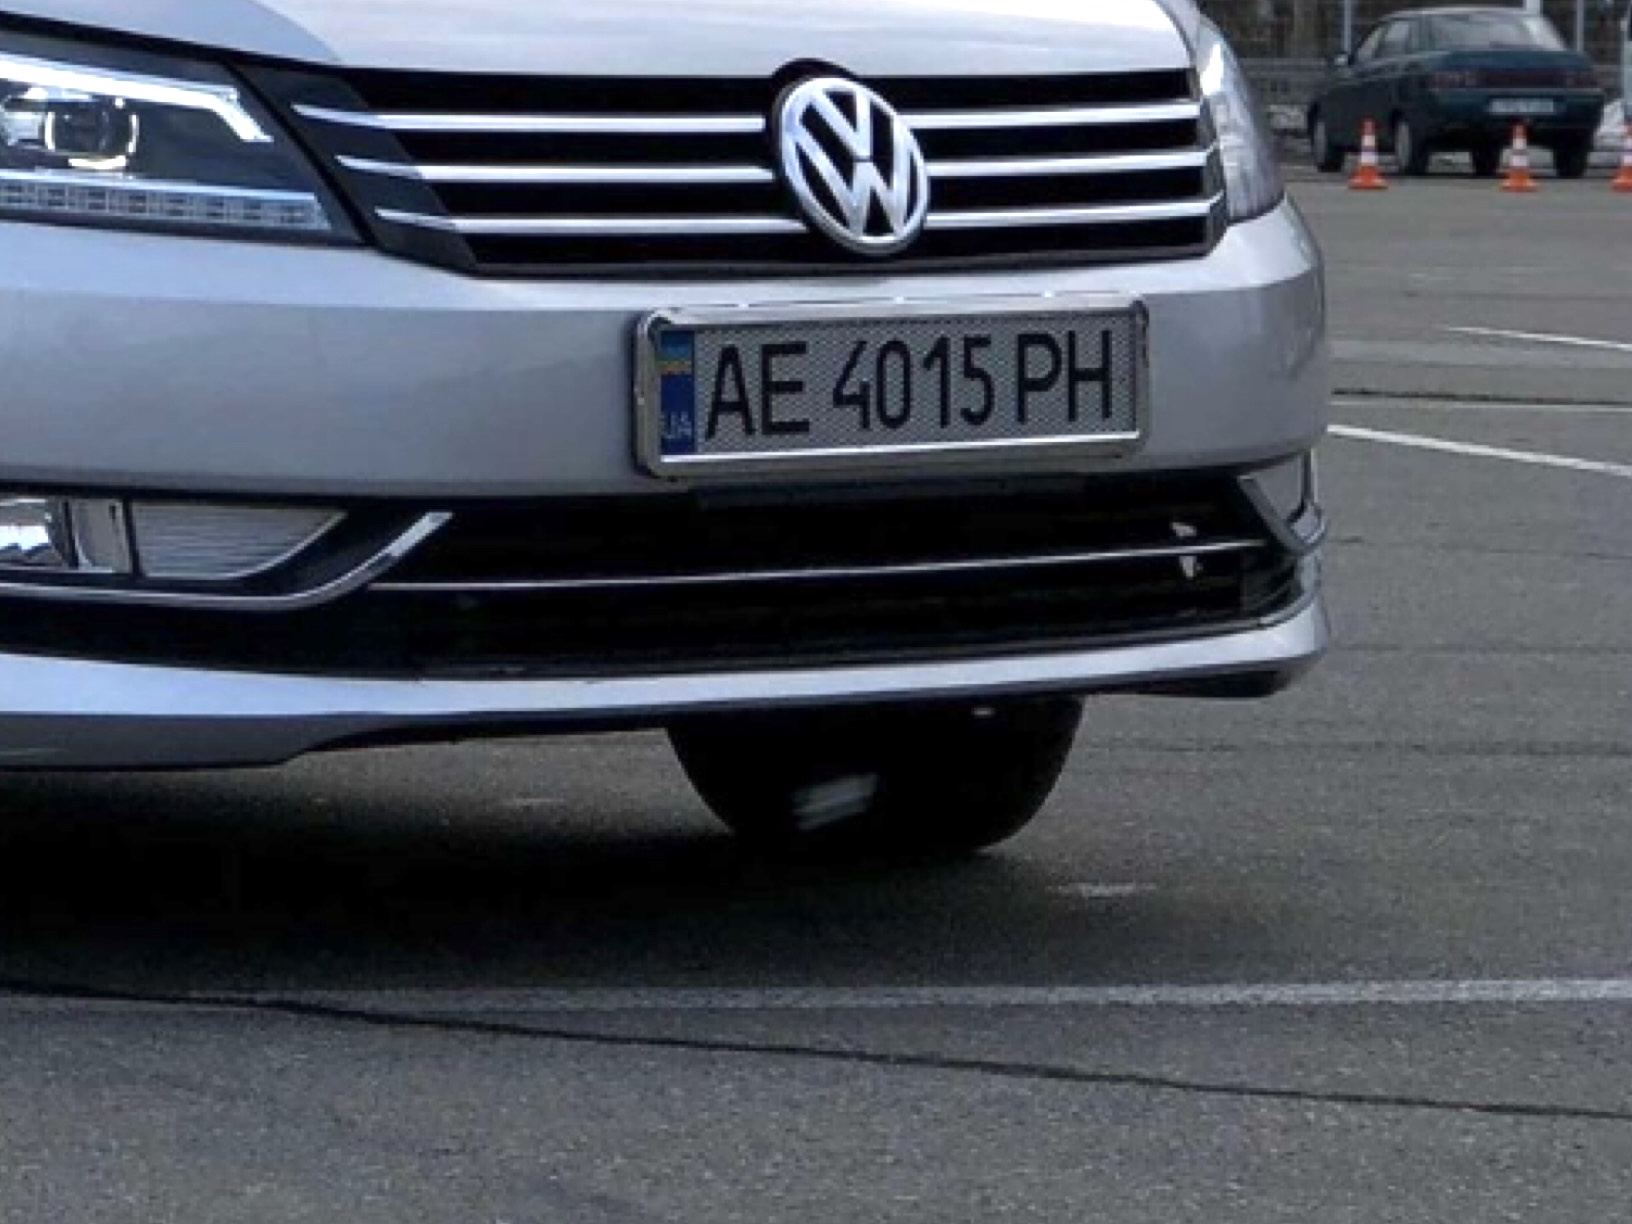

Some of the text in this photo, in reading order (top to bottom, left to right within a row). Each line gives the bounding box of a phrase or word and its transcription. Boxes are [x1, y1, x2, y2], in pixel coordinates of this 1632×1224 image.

[705, 329, 1112, 440] AE 4015 PH
